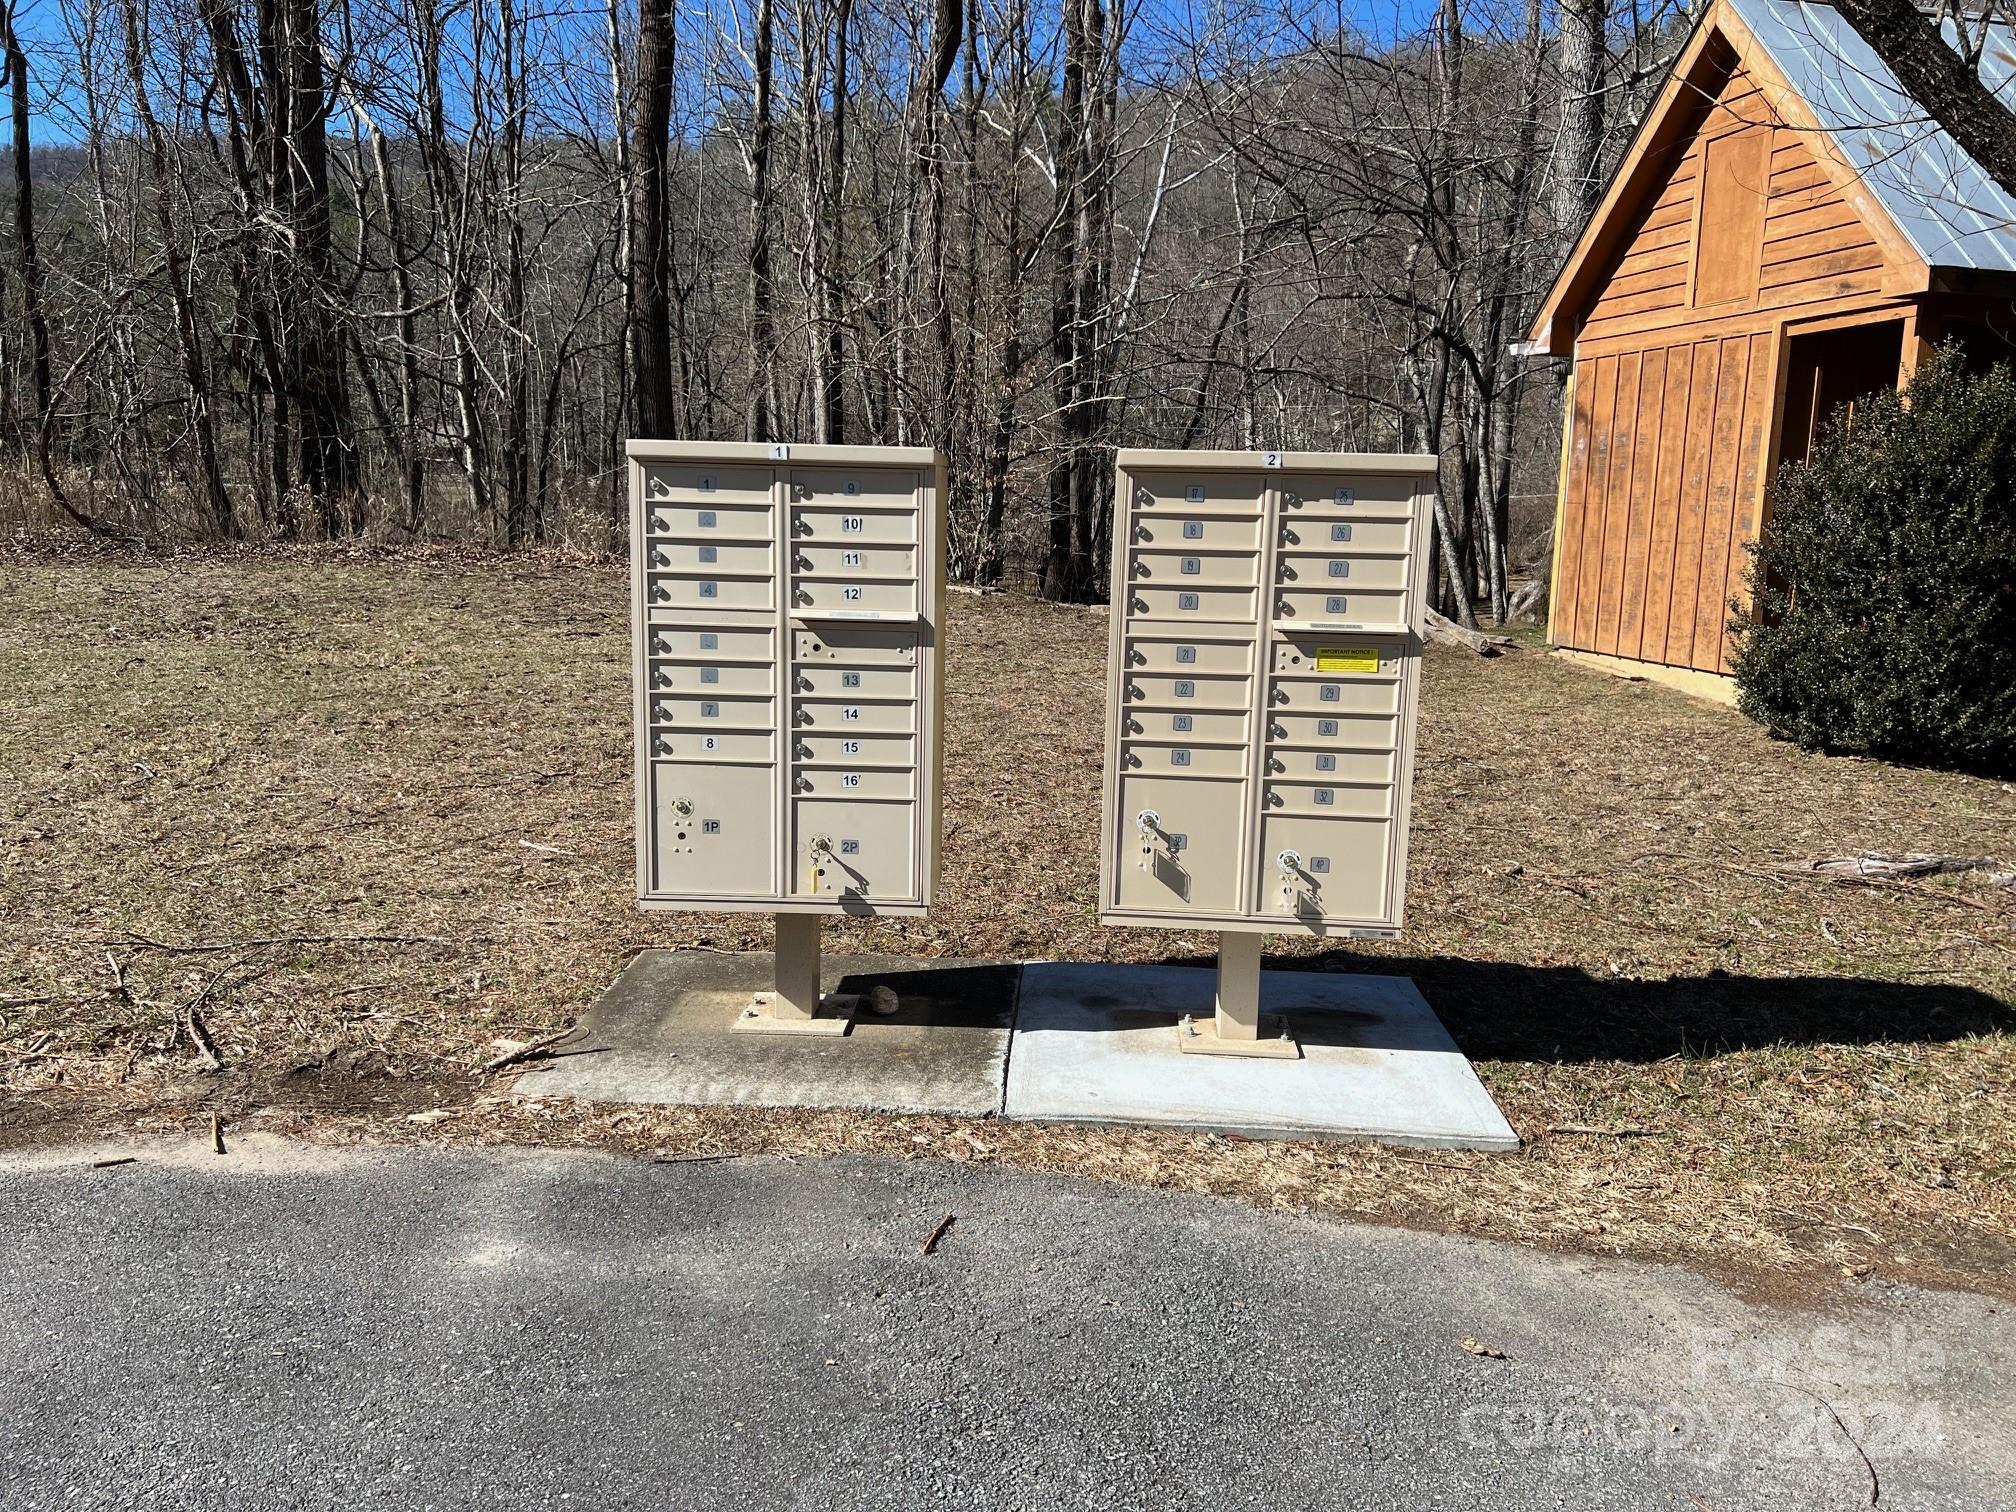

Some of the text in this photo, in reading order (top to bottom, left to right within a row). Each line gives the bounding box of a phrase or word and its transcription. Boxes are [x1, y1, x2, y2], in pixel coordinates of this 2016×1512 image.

[775, 446, 781, 457] 1
[1268, 454, 1276, 466] 2
[703, 479, 710, 489] 1
[847, 482, 855, 493] 9
[1191, 488, 1198, 499] 17
[843, 518, 859, 530] 10
[1336, 528, 1346, 539] 26
[844, 553, 859, 564] 11
[1187, 560, 1194, 571] 19
[1334, 563, 1343, 574] 27
[843, 589, 859, 600] 12
[1184, 596, 1193, 607] 20
[1332, 599, 1341, 610] 28
[1182, 649, 1189, 660] 21
[844, 674, 859, 686] 13
[1180, 683, 1188, 695] 22
[1325, 687, 1334, 699] 29
[706, 704, 714, 715] 7
[843, 709, 859, 719] 14
[1178, 717, 1186, 729] 23
[1323, 722, 1332, 733] 30
[706, 738, 714, 748] 8
[843, 742, 858, 753] 15
[1176, 752, 1185, 763] 24
[1322, 757, 1329, 768] 31
[843, 775, 858, 786] 16
[1319, 791, 1328, 802] 32
[704, 821, 719, 832] 1P
[842, 842, 857, 852] 2P
